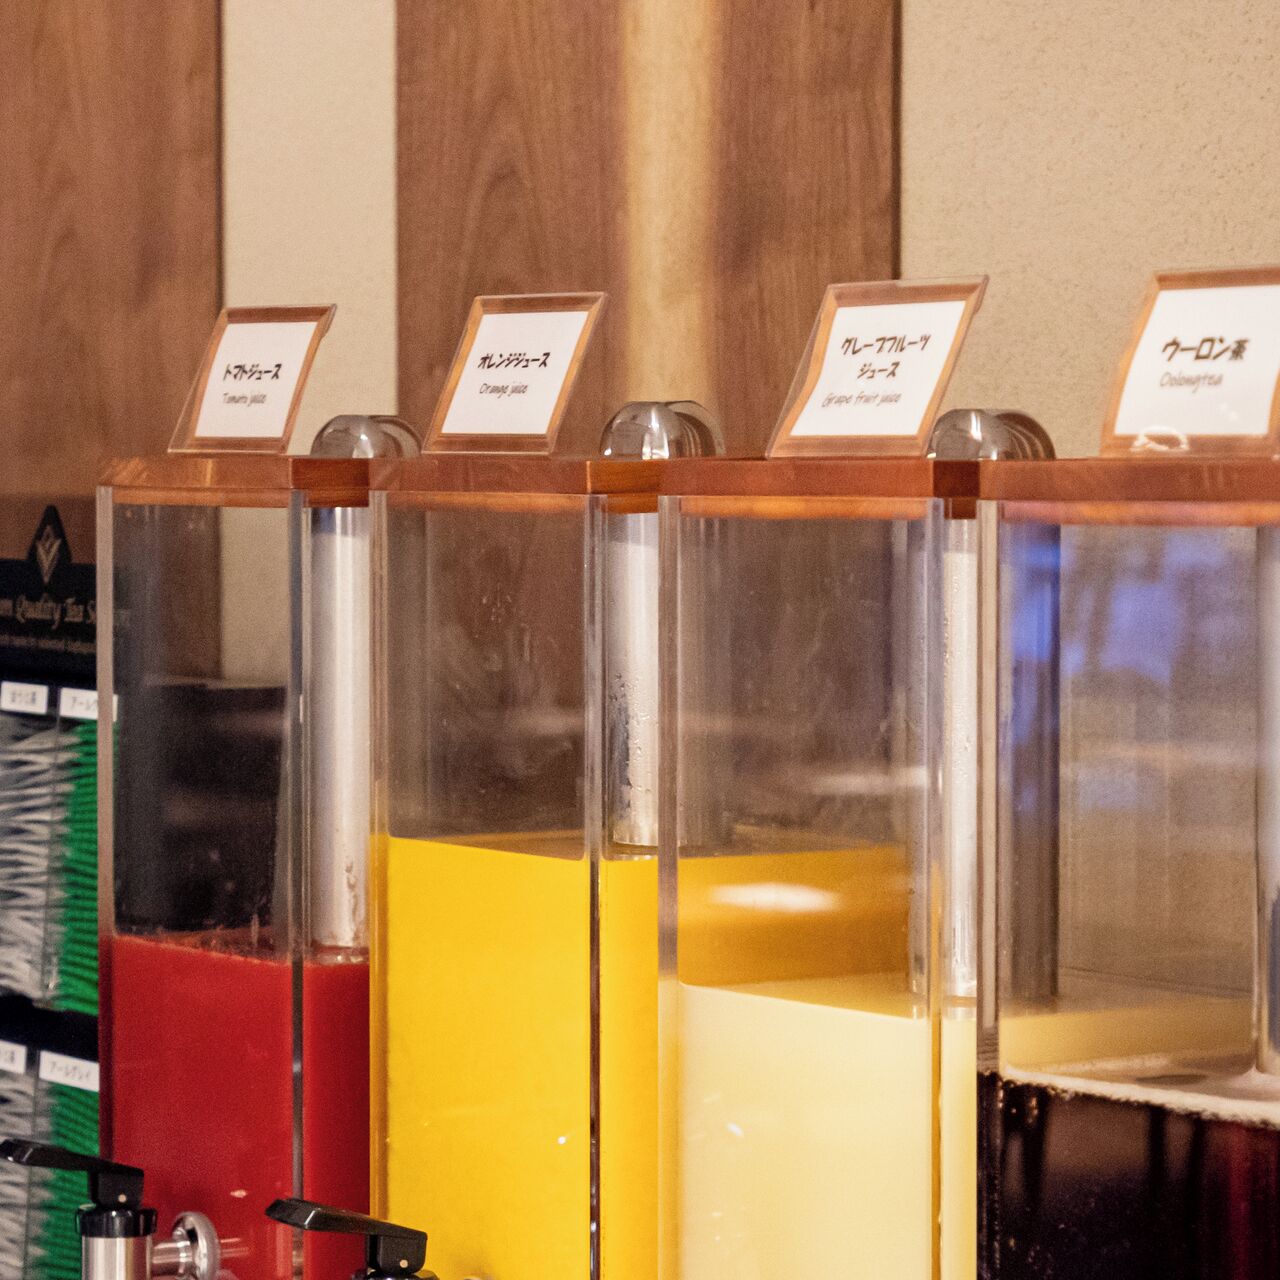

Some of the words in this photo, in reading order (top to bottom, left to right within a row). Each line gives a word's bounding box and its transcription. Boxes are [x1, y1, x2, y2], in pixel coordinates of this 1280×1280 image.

[1161, 336, 1249, 361] ウーロン茶
[477, 352, 550, 369] オレンジジュース
[856, 360, 900, 379] ジュース
[222, 363, 282, 381] トマトジュース
